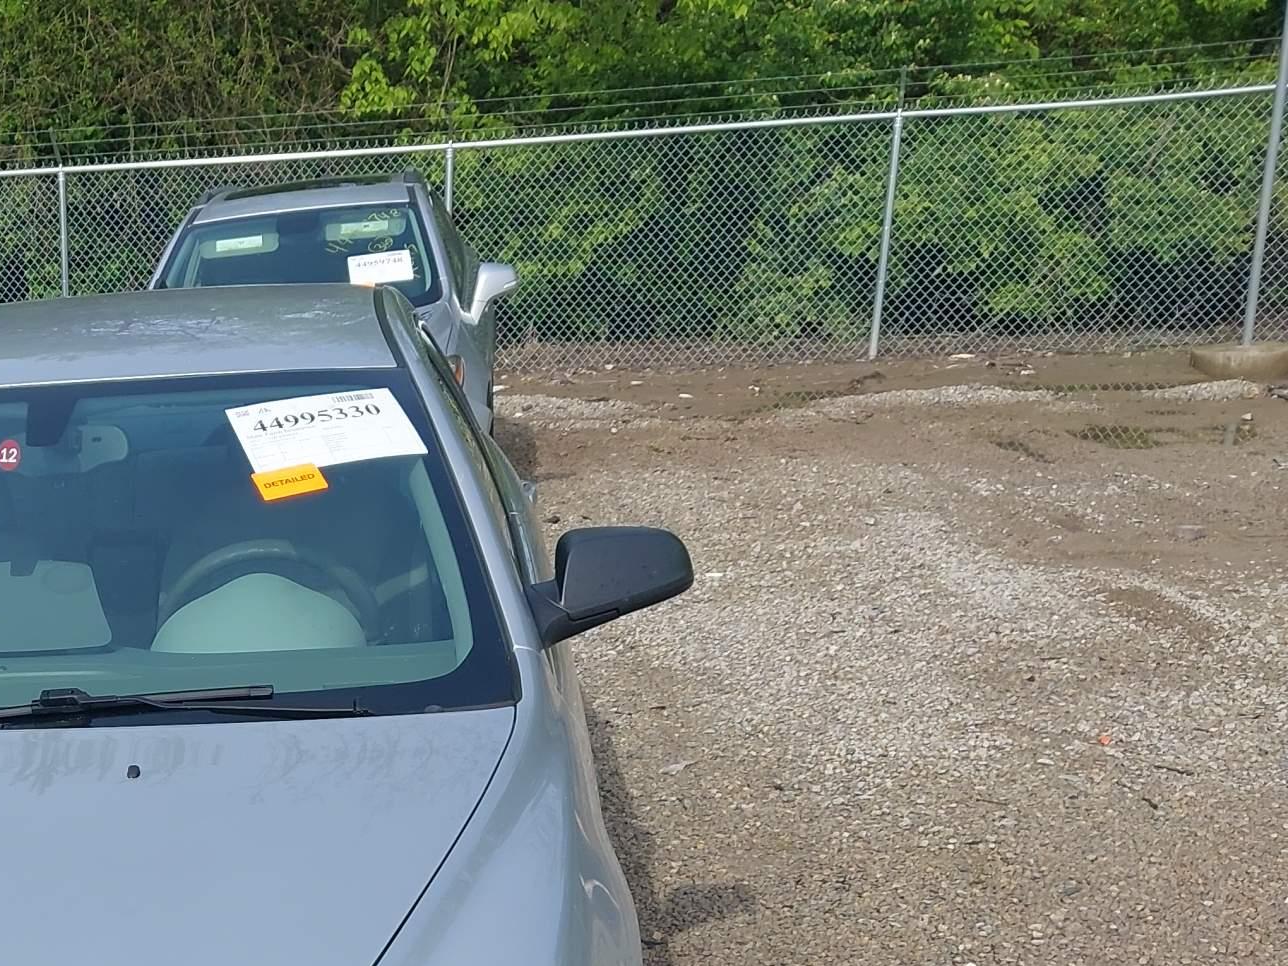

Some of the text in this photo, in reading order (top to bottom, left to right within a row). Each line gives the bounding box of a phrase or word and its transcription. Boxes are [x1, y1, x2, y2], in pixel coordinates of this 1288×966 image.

[253, 403, 381, 432] 44995330
[0, 447, 17, 463] 12
[263, 473, 315, 489] DETAILED
